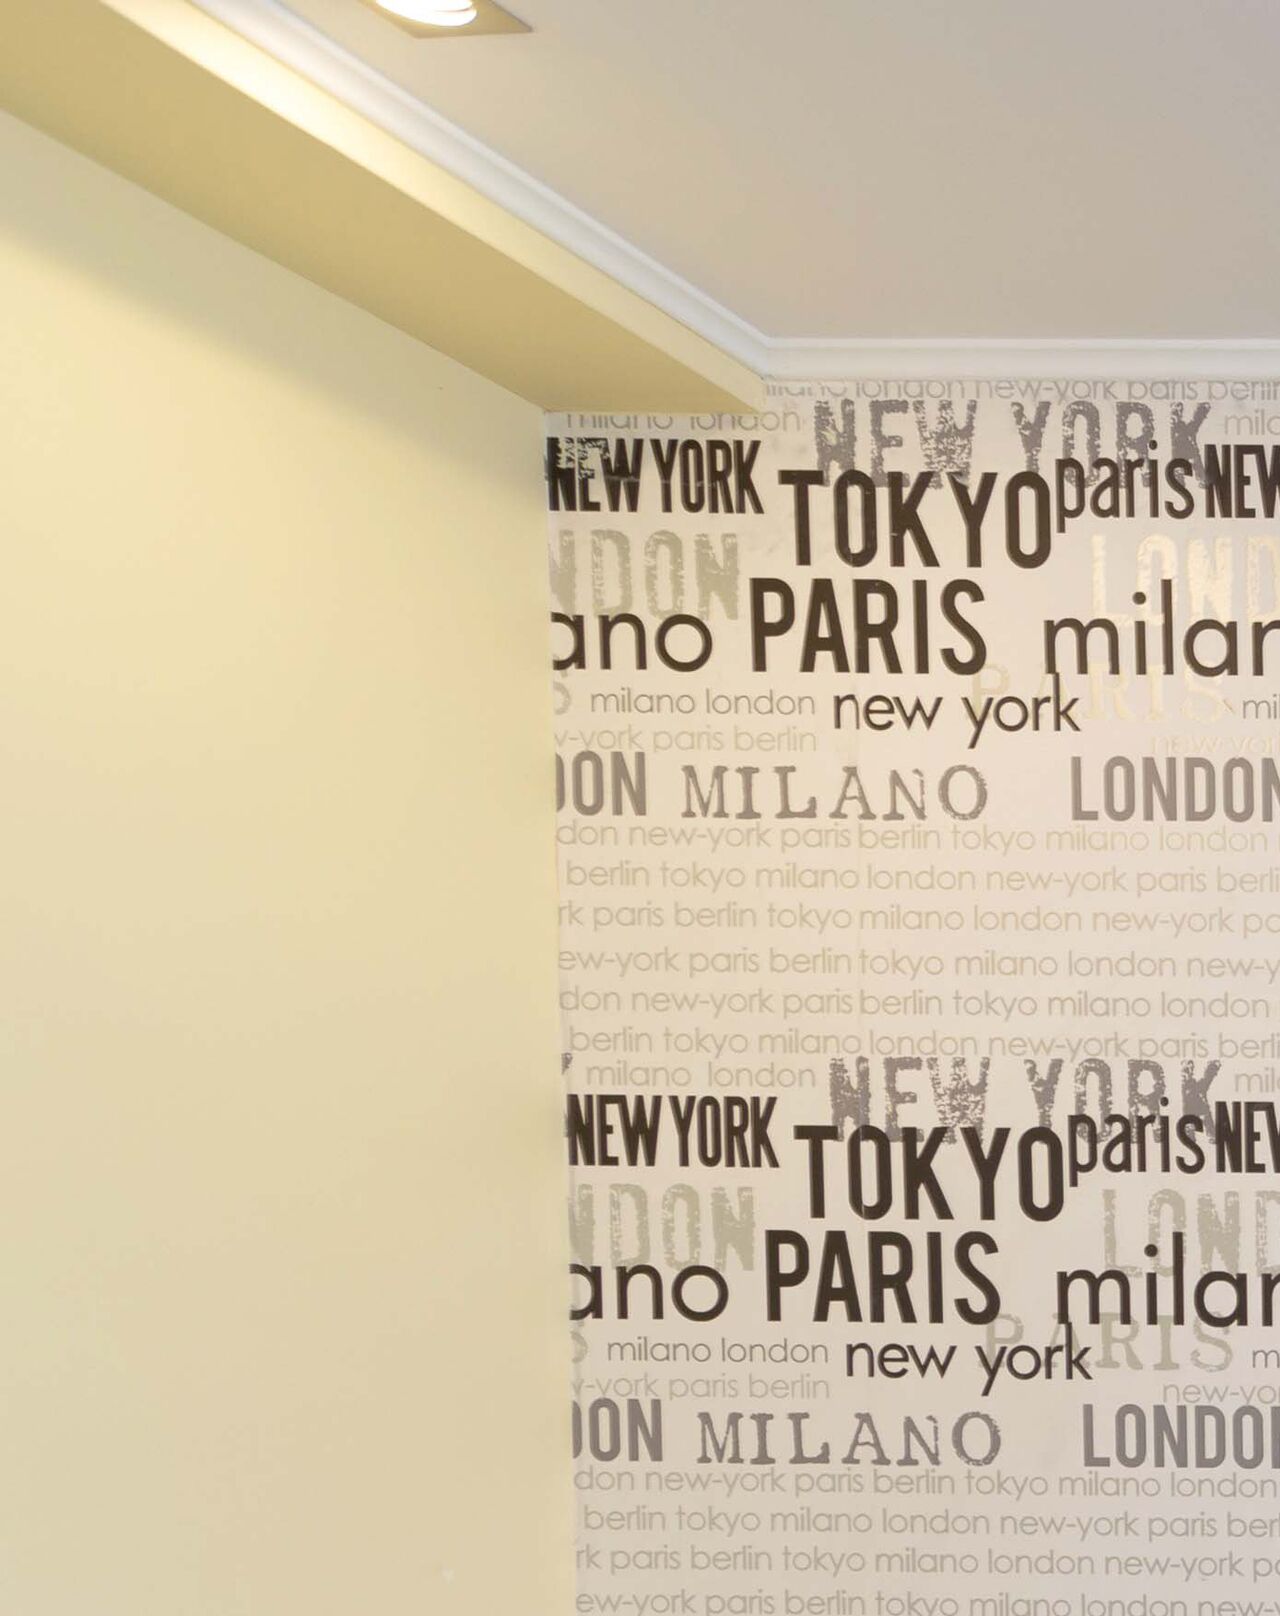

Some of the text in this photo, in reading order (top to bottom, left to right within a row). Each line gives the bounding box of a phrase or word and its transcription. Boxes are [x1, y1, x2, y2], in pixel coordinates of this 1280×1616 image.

[778, 469, 1051, 569] TOKYO
[1055, 440, 1194, 533] paris
[750, 578, 986, 675] PARIS
[590, 687, 814, 715] milano london
[833, 673, 1081, 749] new york
[681, 765, 987, 821] MILANO
[567, 860, 976, 894] berlin tokyo milano london
[1137, 868, 1206, 895] paris
[567, 1094, 779, 1168] NEW YORK
[1068, 1097, 1205, 1187] paris
[793, 1125, 1064, 1222] TOKYO
[765, 1230, 1001, 1325] PARIS
[608, 1337, 827, 1363] milano london
[846, 1321, 1092, 1396] new york
[697, 1411, 1002, 1466] MILANO
[645, 1468, 1048, 1500] new-york paris berlin tokyo
